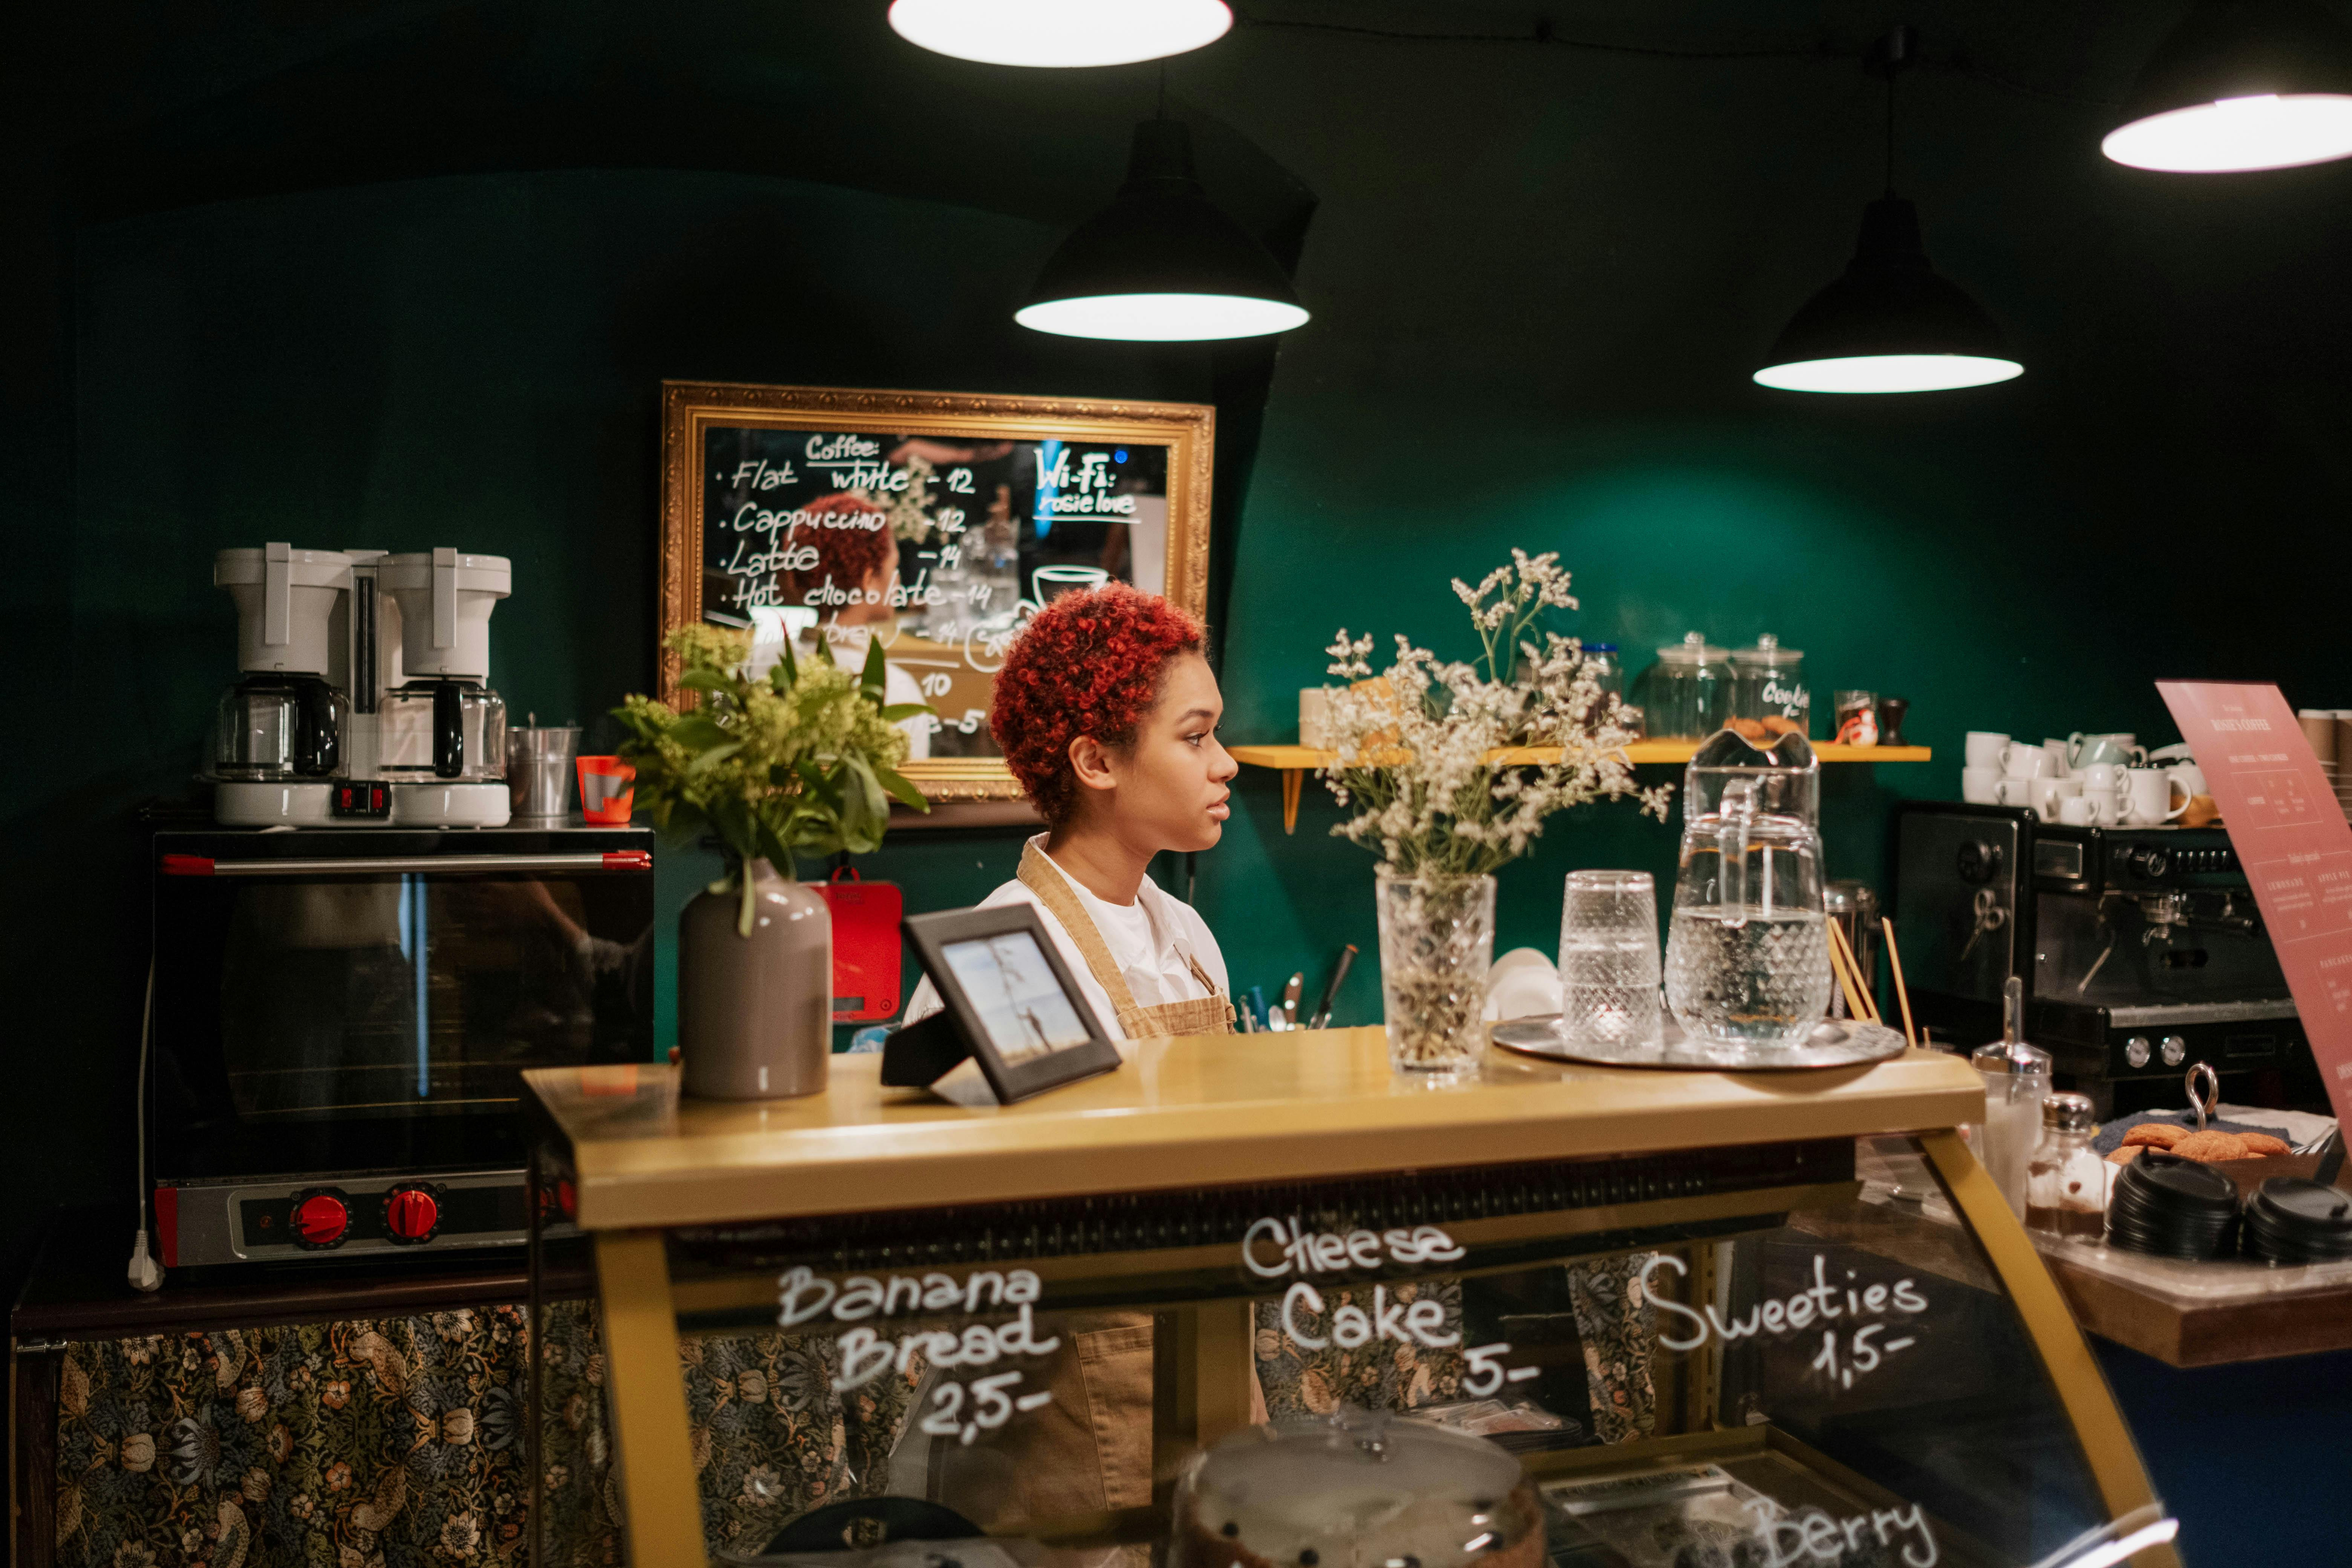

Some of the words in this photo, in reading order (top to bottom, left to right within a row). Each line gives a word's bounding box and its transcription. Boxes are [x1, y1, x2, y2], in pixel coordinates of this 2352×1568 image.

[731, 459, 798, 490] Flat
[831, 459, 909, 491] white
[733, 502, 886, 544] Cappuccino
[727, 539, 819, 577] Latte
[732, 574, 784, 609] Hot
[804, 567, 947, 608] chocolate
[1242, 1215, 1467, 1278] Cheese
[776, 1265, 1042, 1328] Banana
[1282, 1282, 1461, 1349] Cake
[1640, 1254, 1928, 1351] Sweeties
[831, 1302, 1060, 1392] Bread
[1741, 1494, 1938, 1568] Berry
